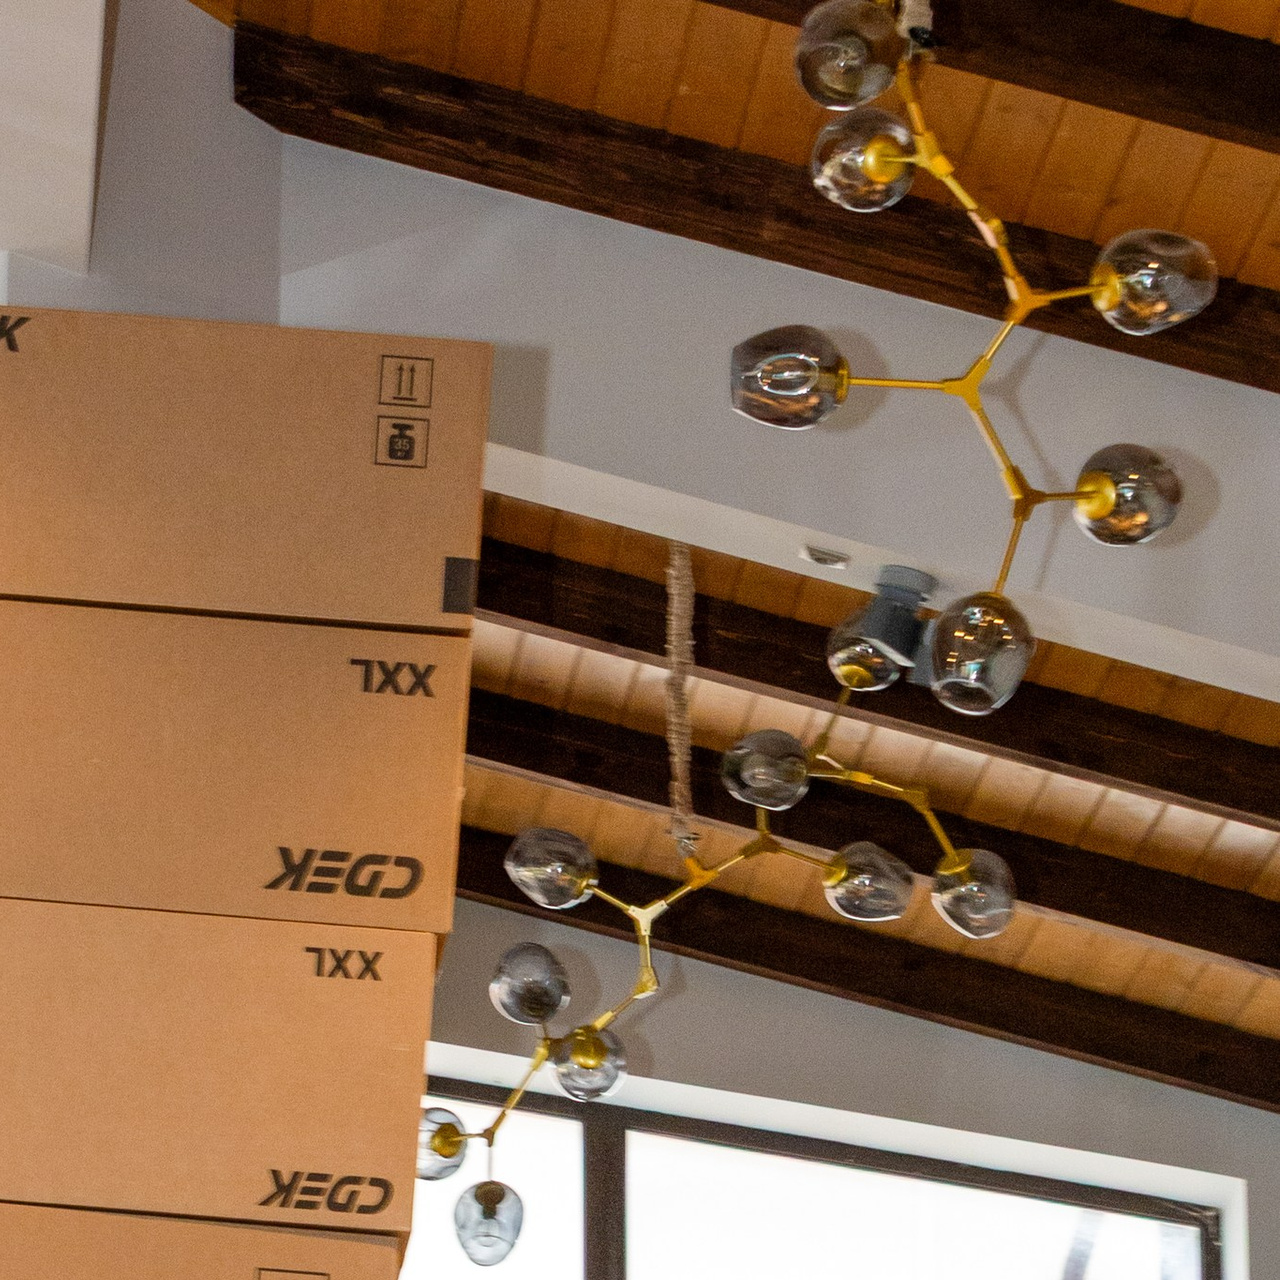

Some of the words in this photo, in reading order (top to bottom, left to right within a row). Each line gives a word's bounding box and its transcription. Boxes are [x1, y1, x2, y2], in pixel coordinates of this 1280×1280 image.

[394, 439, 410, 450] 35
[349, 658, 436, 697] XXL
[264, 847, 423, 899] CDEK
[305, 947, 382, 981] XXL
[257, 1169, 394, 1215] CDEK
